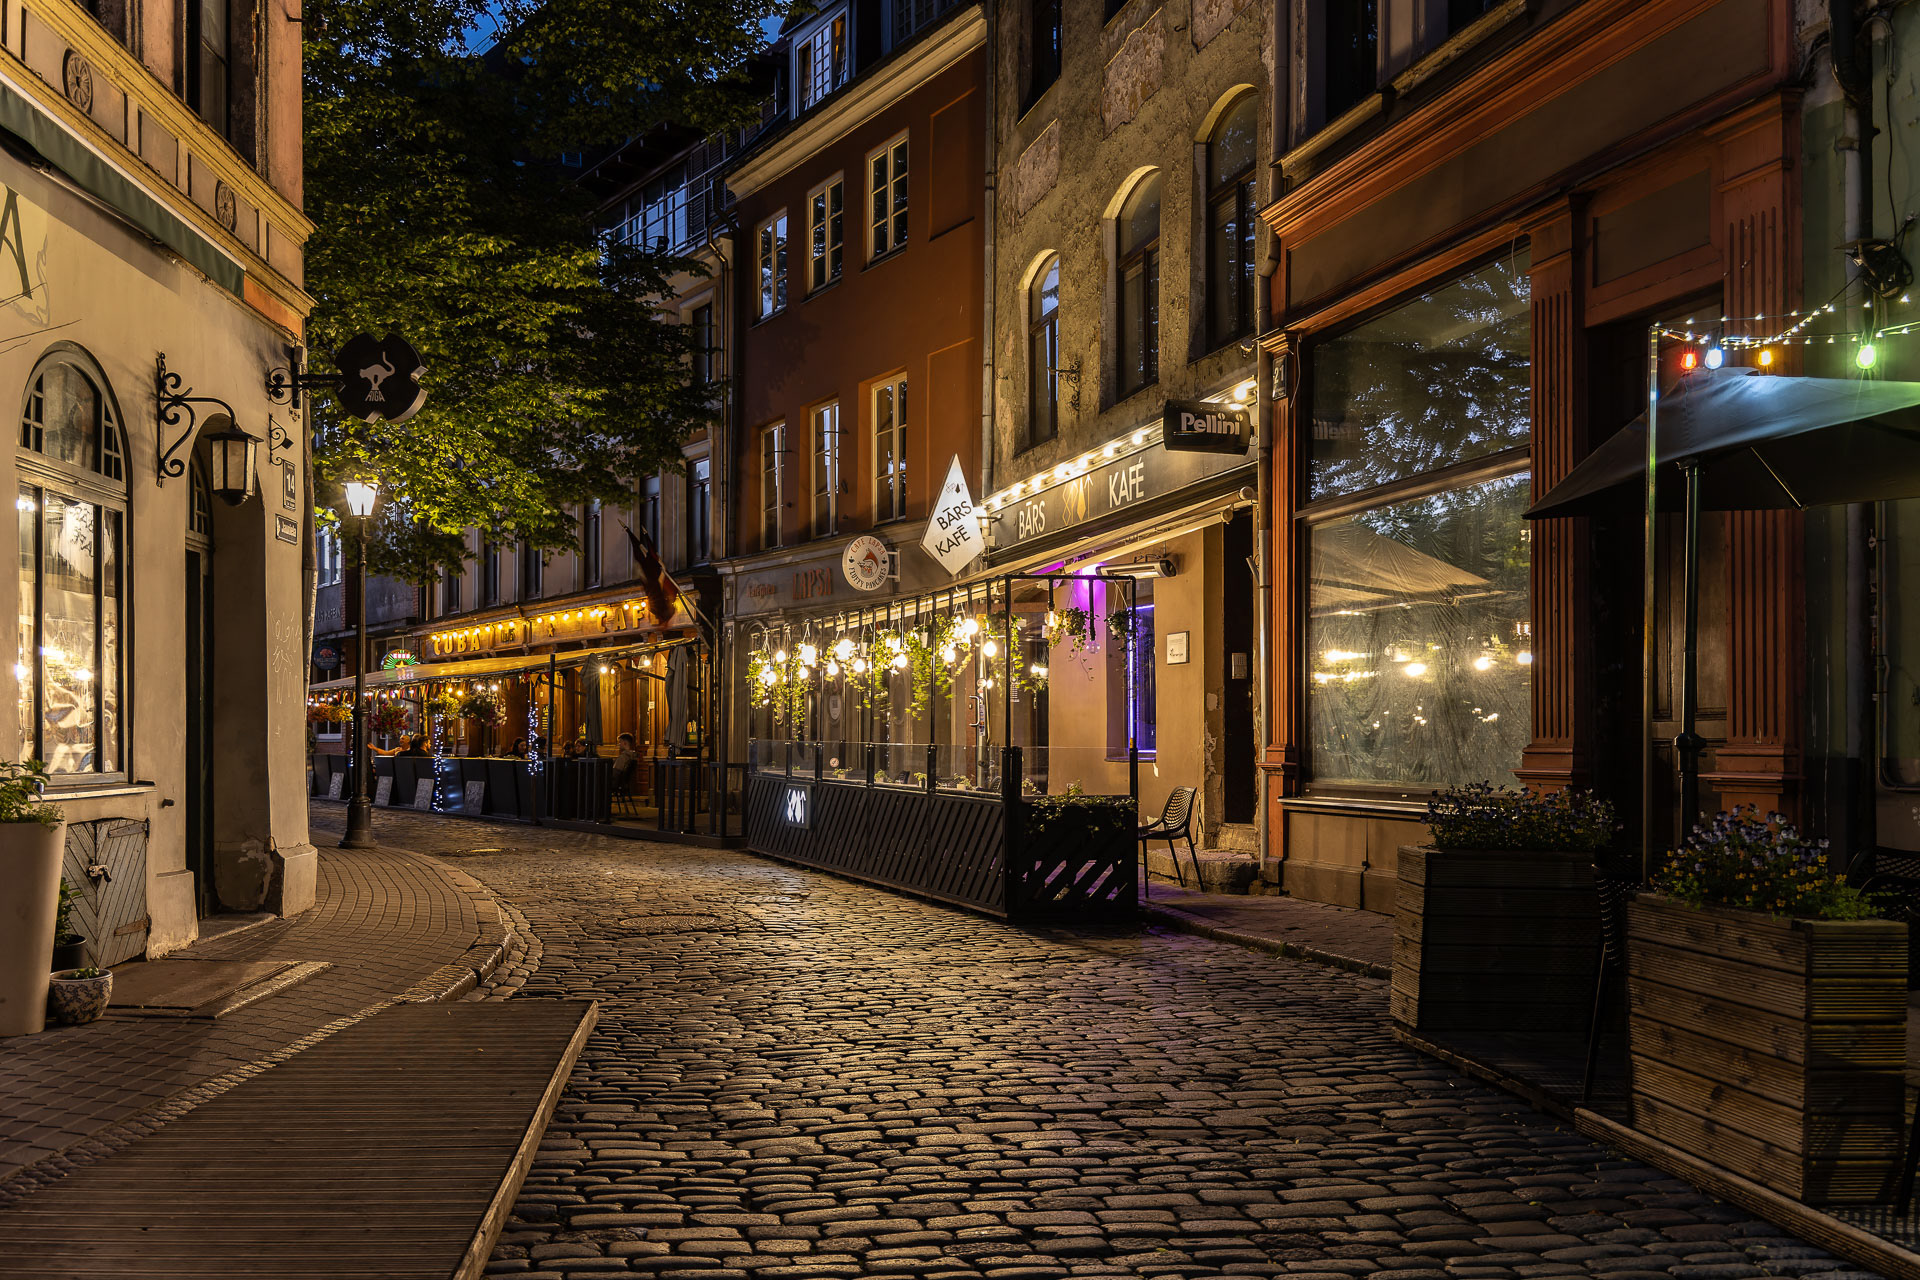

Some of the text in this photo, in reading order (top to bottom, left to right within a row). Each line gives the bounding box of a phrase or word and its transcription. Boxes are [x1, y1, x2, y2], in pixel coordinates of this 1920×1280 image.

[1274, 364, 1285, 385] 21
[1180, 412, 1243, 436] Pellini
[286, 473, 295, 494] 14
[936, 500, 972, 531] BĀRS
[1018, 500, 1046, 540] BĀRS
[792, 567, 832, 600] LAPSA
[849, 567, 865, 588] FLUFFY
[434, 632, 481, 656] CUBA
